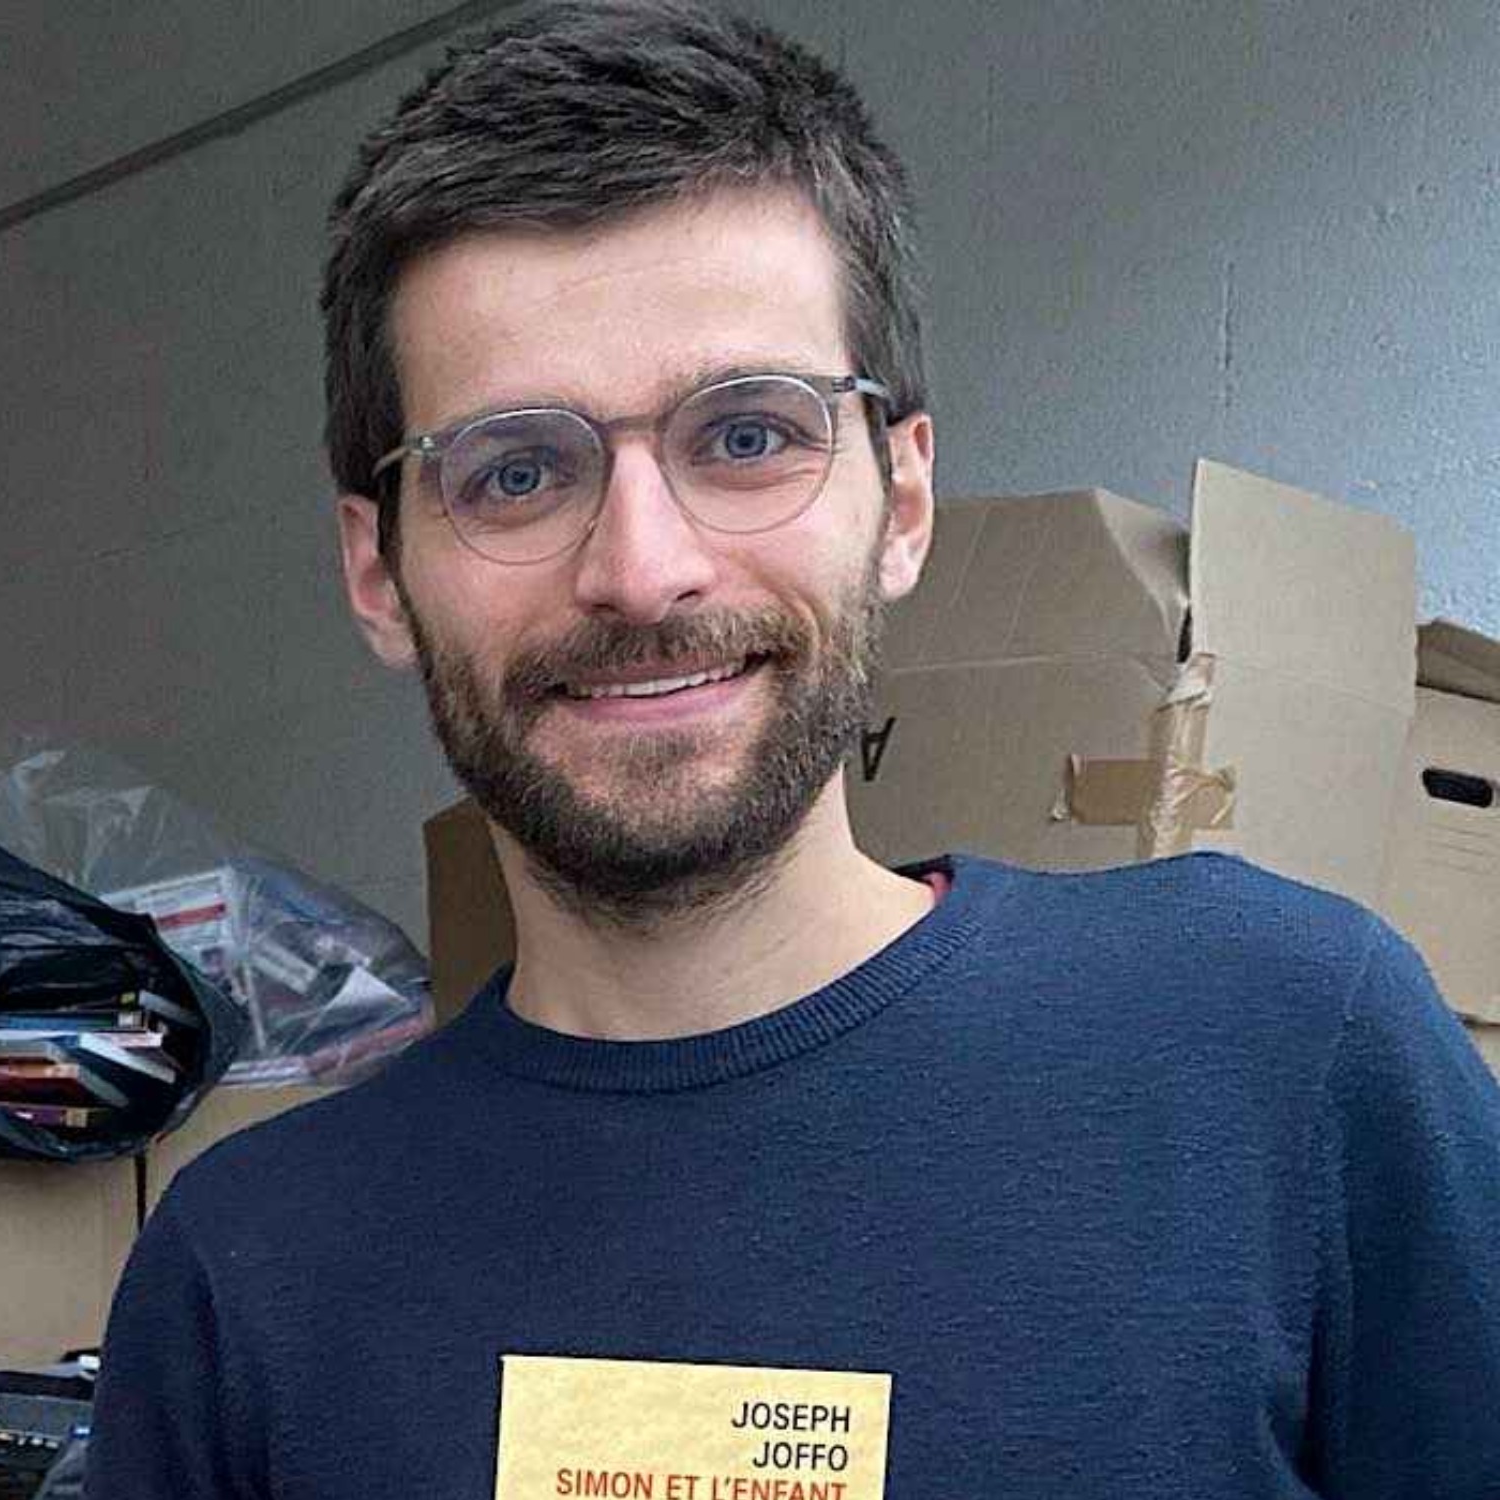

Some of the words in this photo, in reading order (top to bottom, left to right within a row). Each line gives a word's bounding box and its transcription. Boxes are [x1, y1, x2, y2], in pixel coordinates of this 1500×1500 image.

[731, 1402, 851, 1433] JOSEPH
[752, 1442, 849, 1471] JOFFO
[555, 1468, 653, 1500] SIMON
